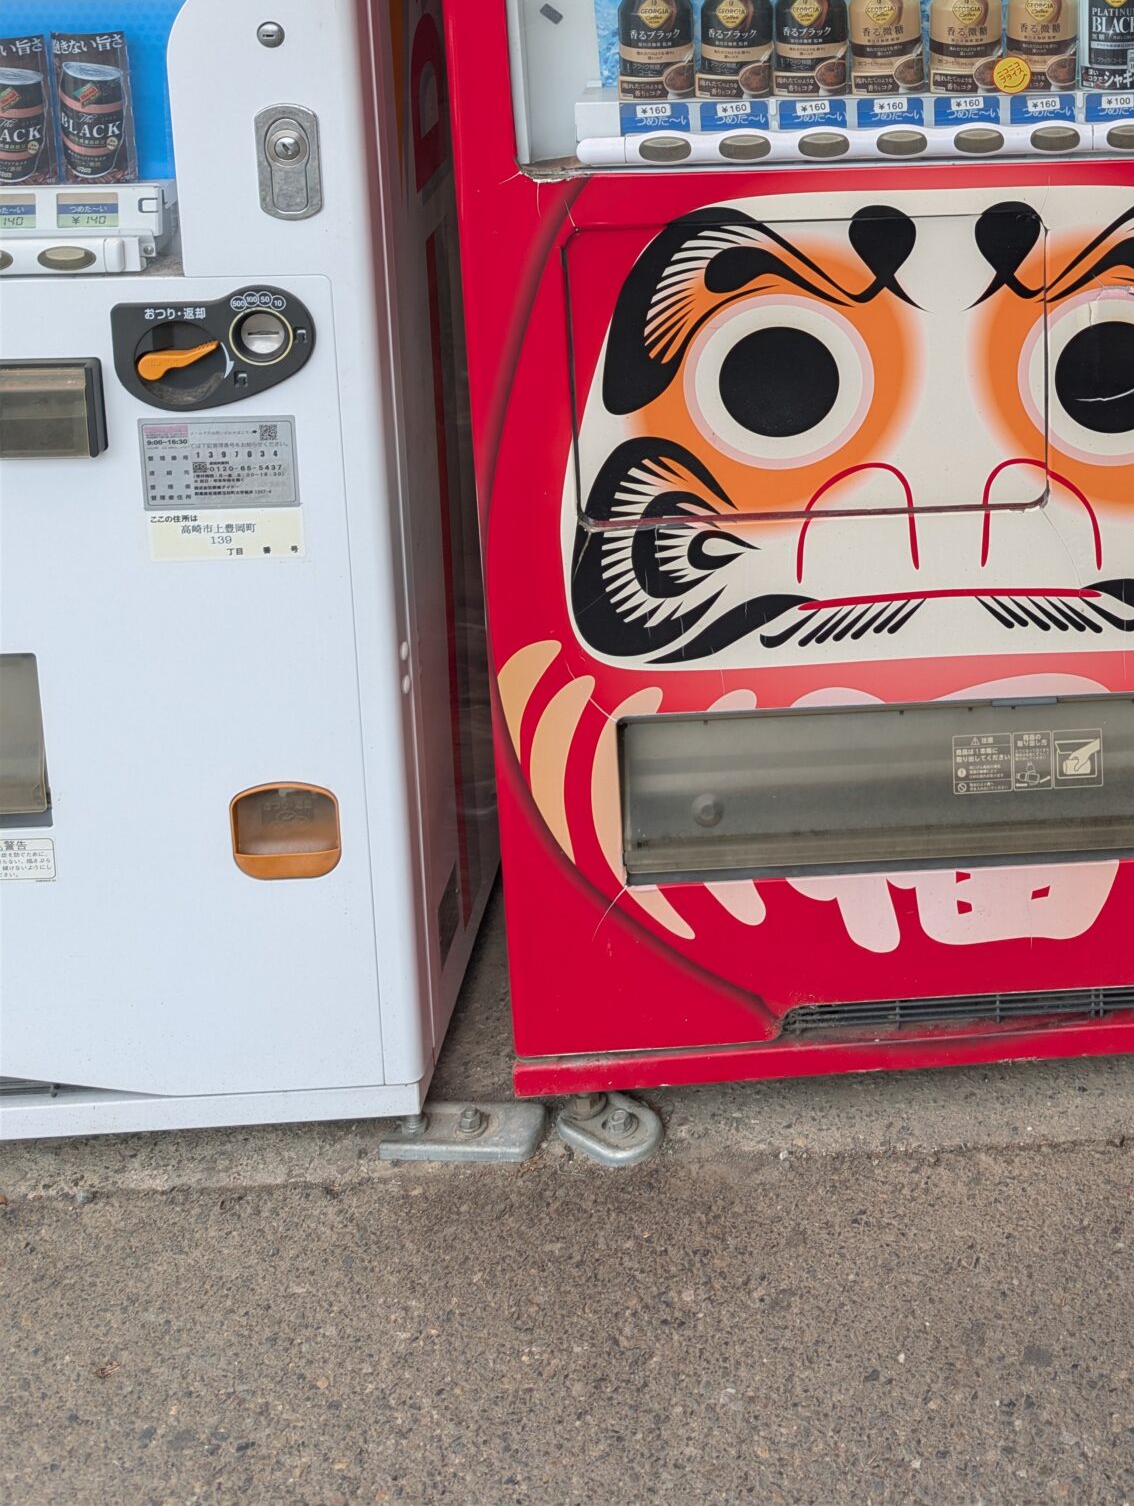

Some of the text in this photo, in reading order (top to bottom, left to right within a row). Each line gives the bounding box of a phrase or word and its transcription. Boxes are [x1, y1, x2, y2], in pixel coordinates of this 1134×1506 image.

[630, 28, 680, 40] 香るブラック
[708, 28, 757, 40] 香るブラック
[1106, 97, 1131, 106] ¥100
[61, 111, 121, 138] BLACK
[144, 307, 206, 320] おつり・返却
[150, 515, 198, 523] ここの住所は
[181, 523, 257, 534] 高崎市上豊岡町
[210, 535, 232, 545] 139
[226, 547, 244, 556] 丁目
[291, 545, 299, 553] 号
